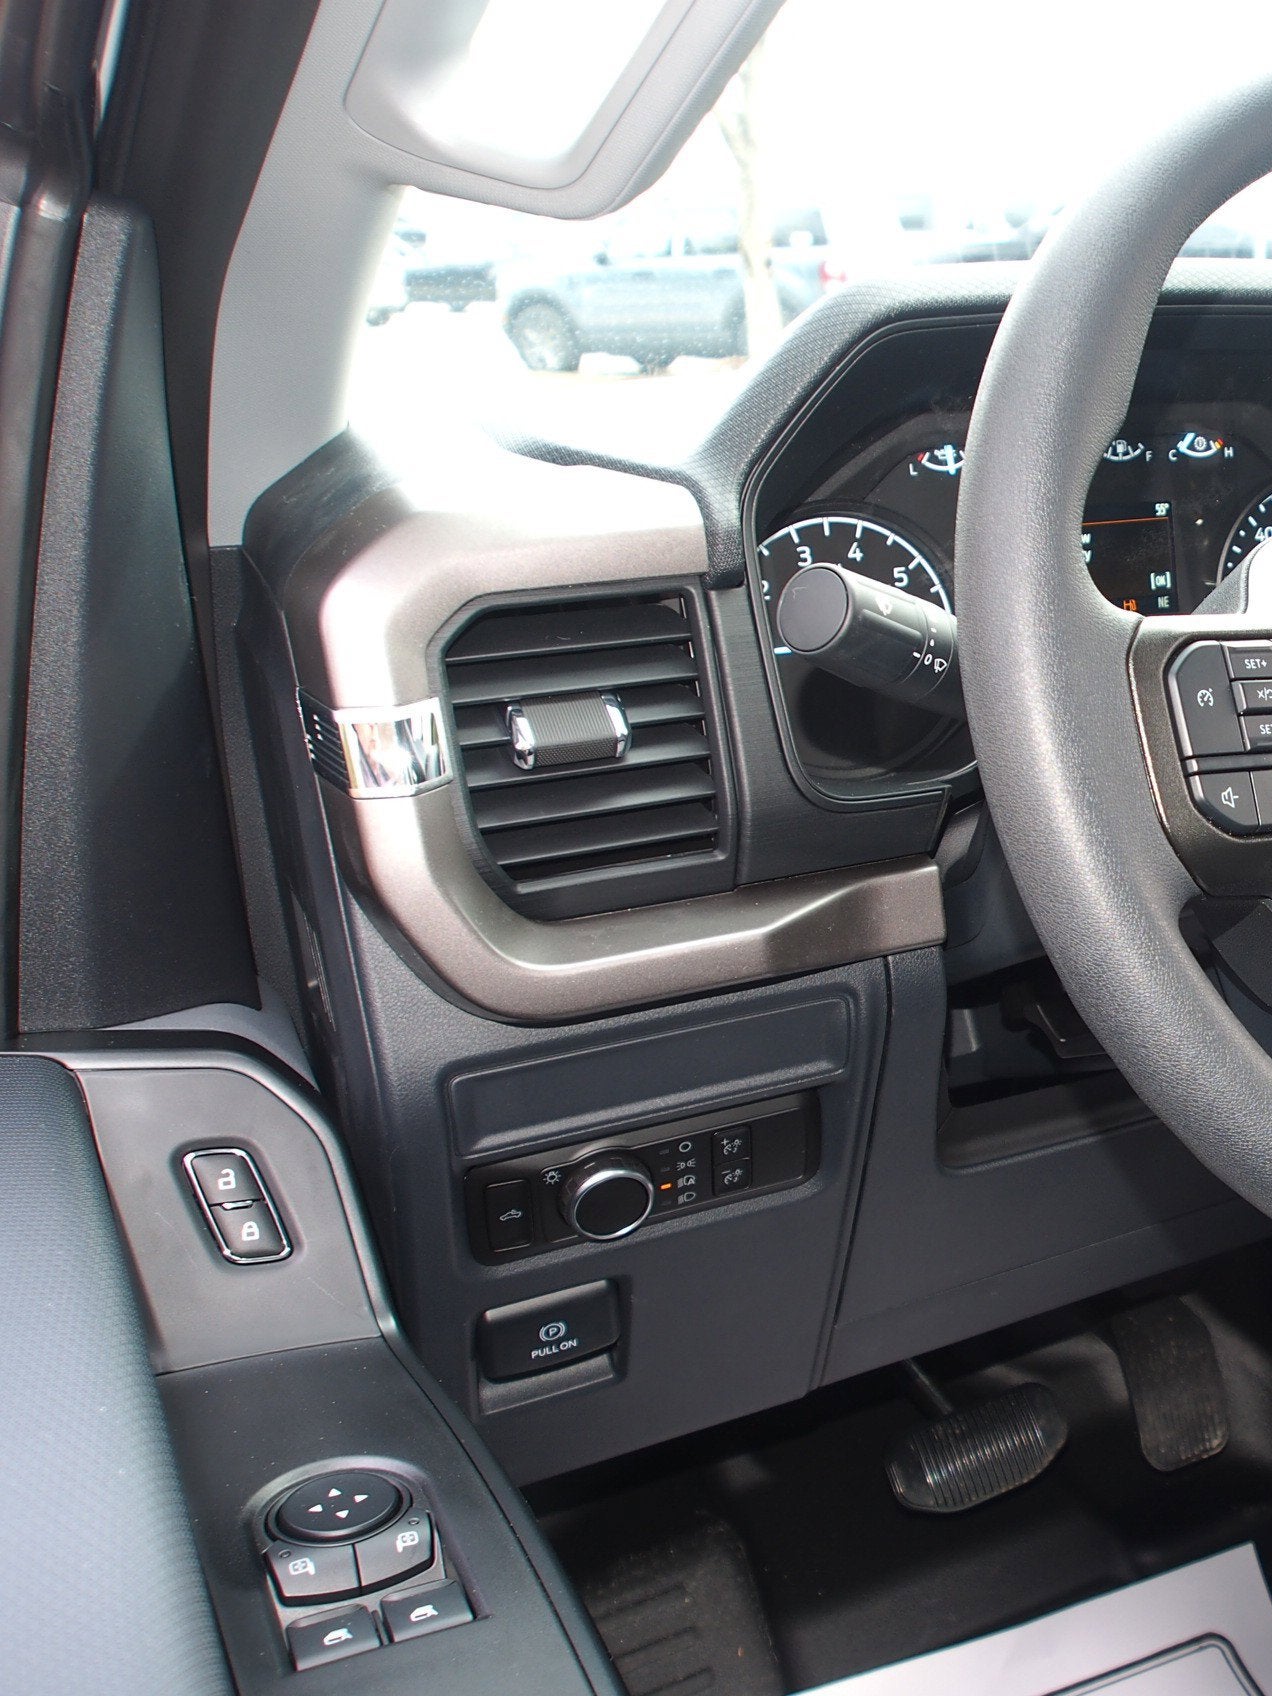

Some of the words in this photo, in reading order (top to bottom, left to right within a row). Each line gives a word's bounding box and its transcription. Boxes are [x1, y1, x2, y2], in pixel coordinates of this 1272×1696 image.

[1145, 450, 1153, 462] F
[1168, 449, 1178, 462] C
[1224, 446, 1234, 458] H
[908, 463, 918, 476] L
[796, 545, 813, 567] 3
[847, 541, 864, 562] 4
[893, 566, 909, 587] 5
[531, 1345, 559, 1359] PULL
[560, 1338, 577, 1351] ON
